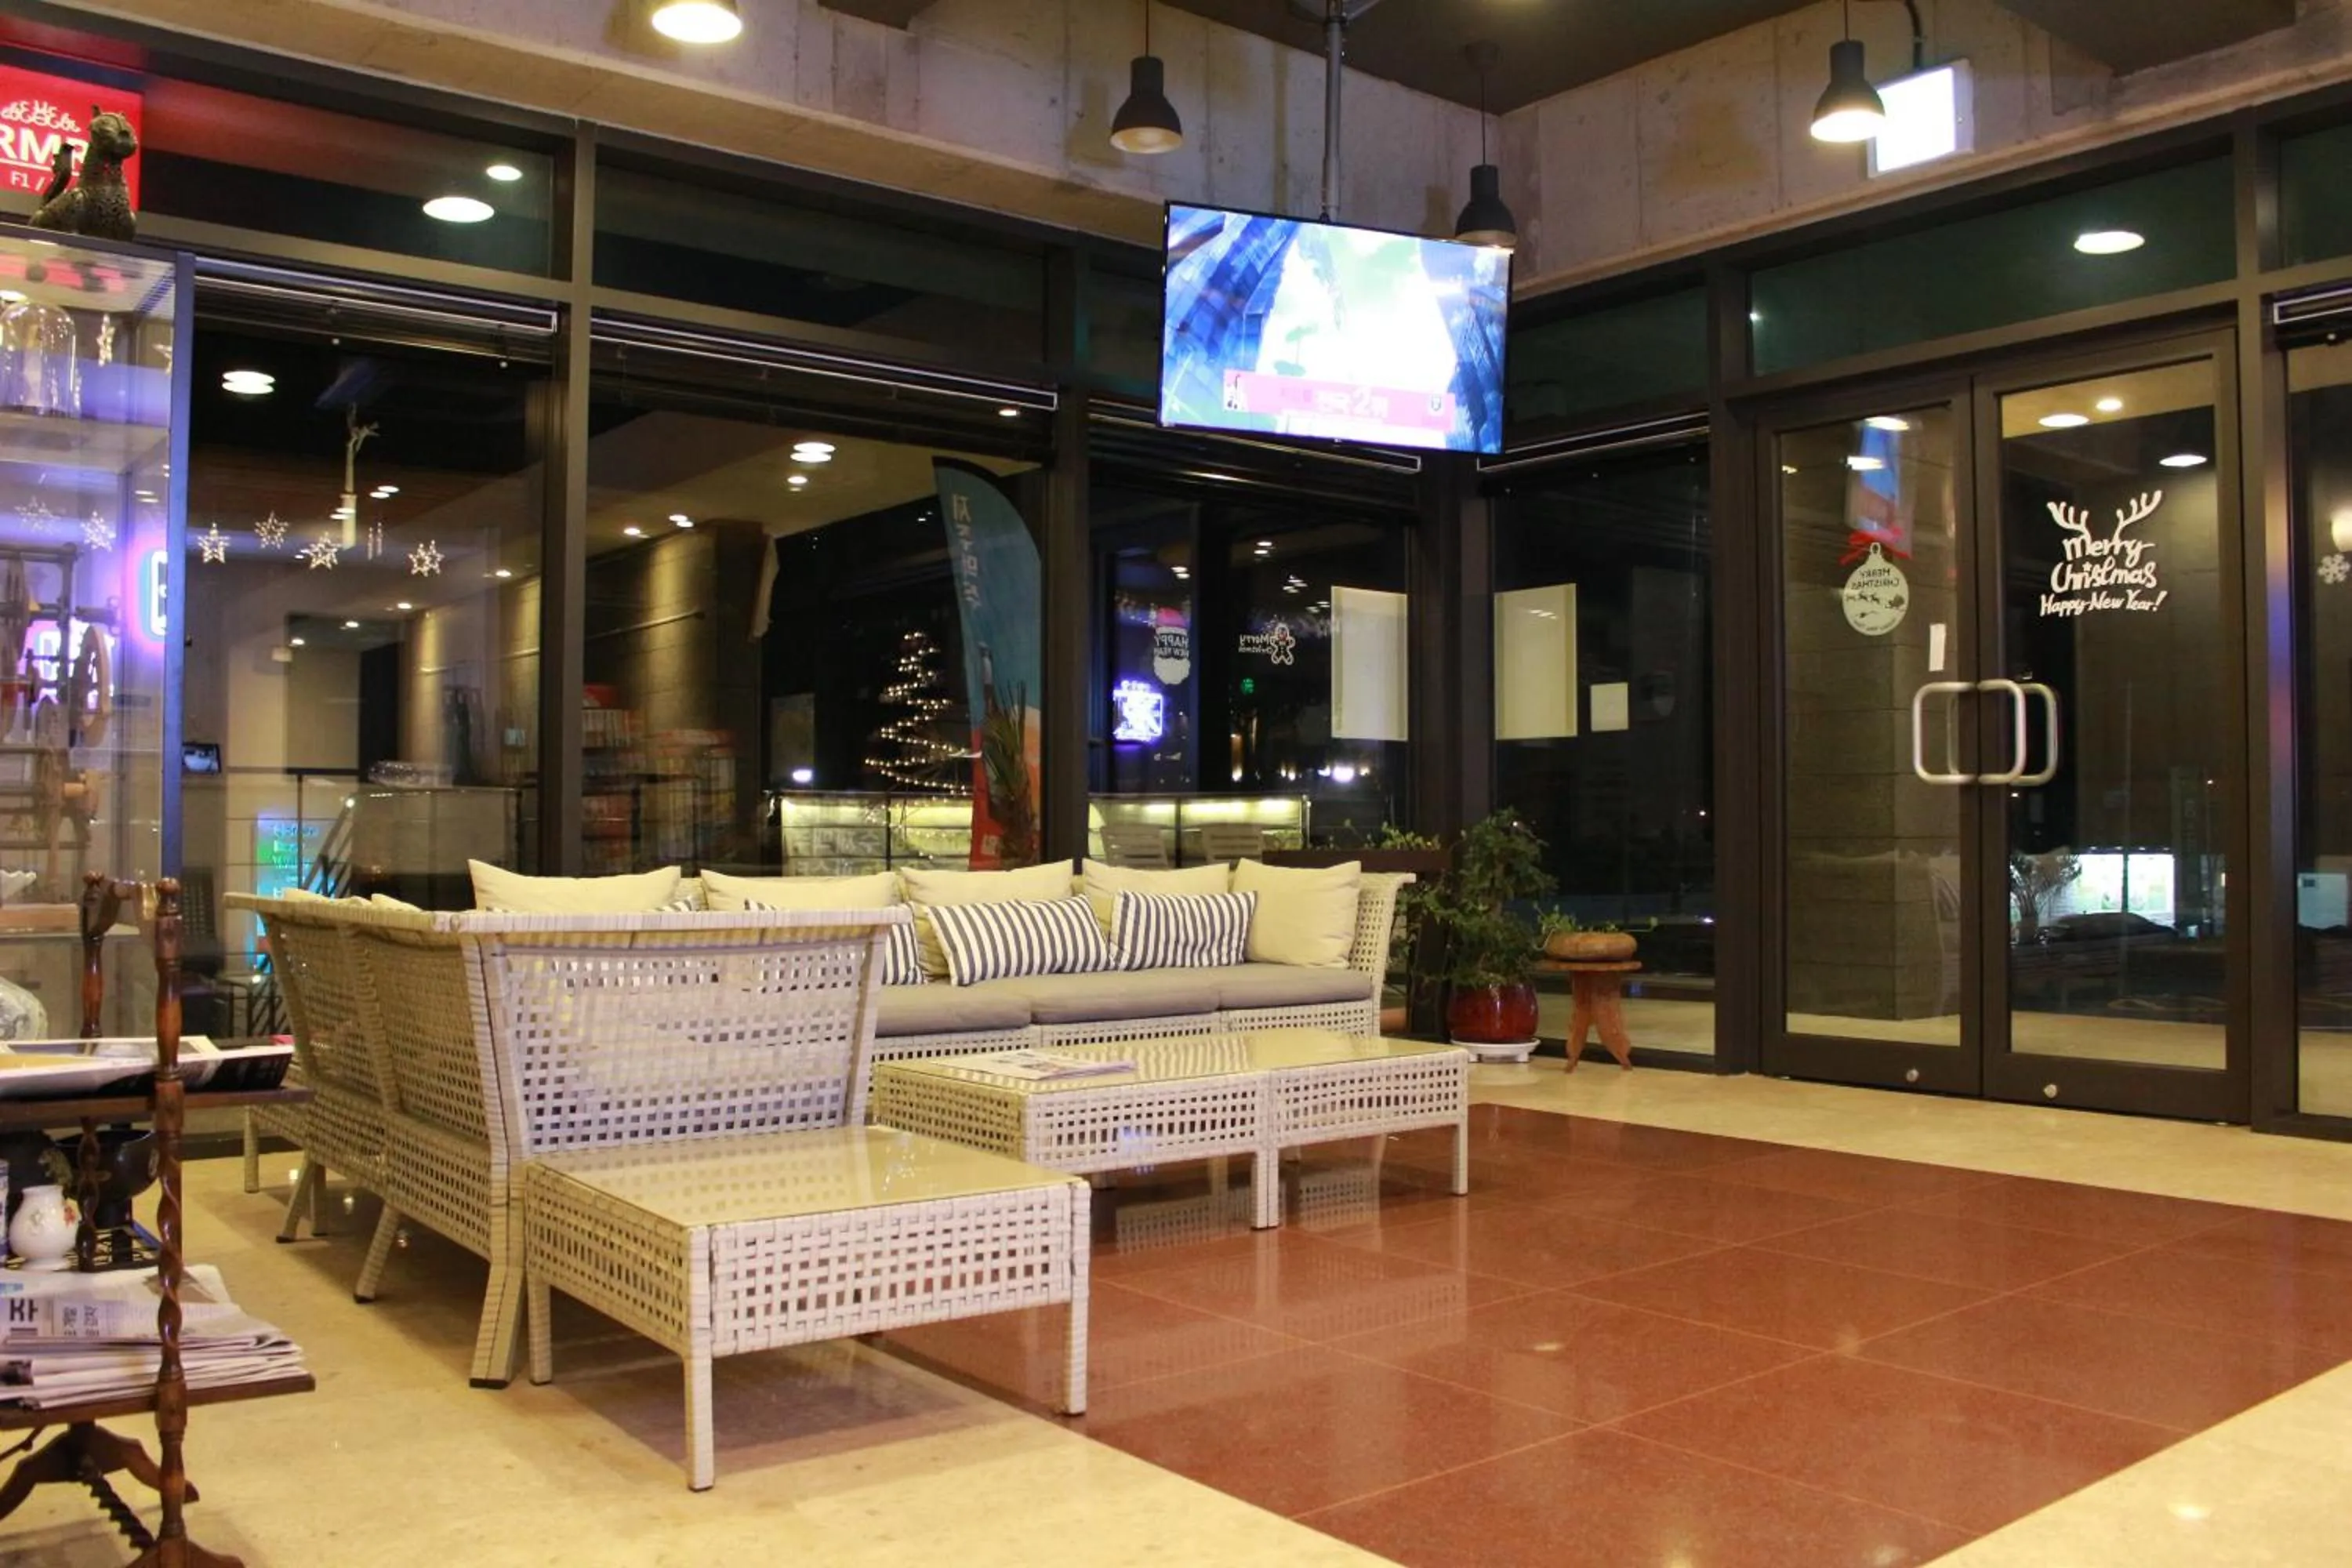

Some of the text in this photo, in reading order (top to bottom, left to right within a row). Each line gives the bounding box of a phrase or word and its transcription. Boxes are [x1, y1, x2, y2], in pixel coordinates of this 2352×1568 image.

[2050, 555, 2157, 593] Christmas
[2040, 589, 2168, 618] Happy New Year!
